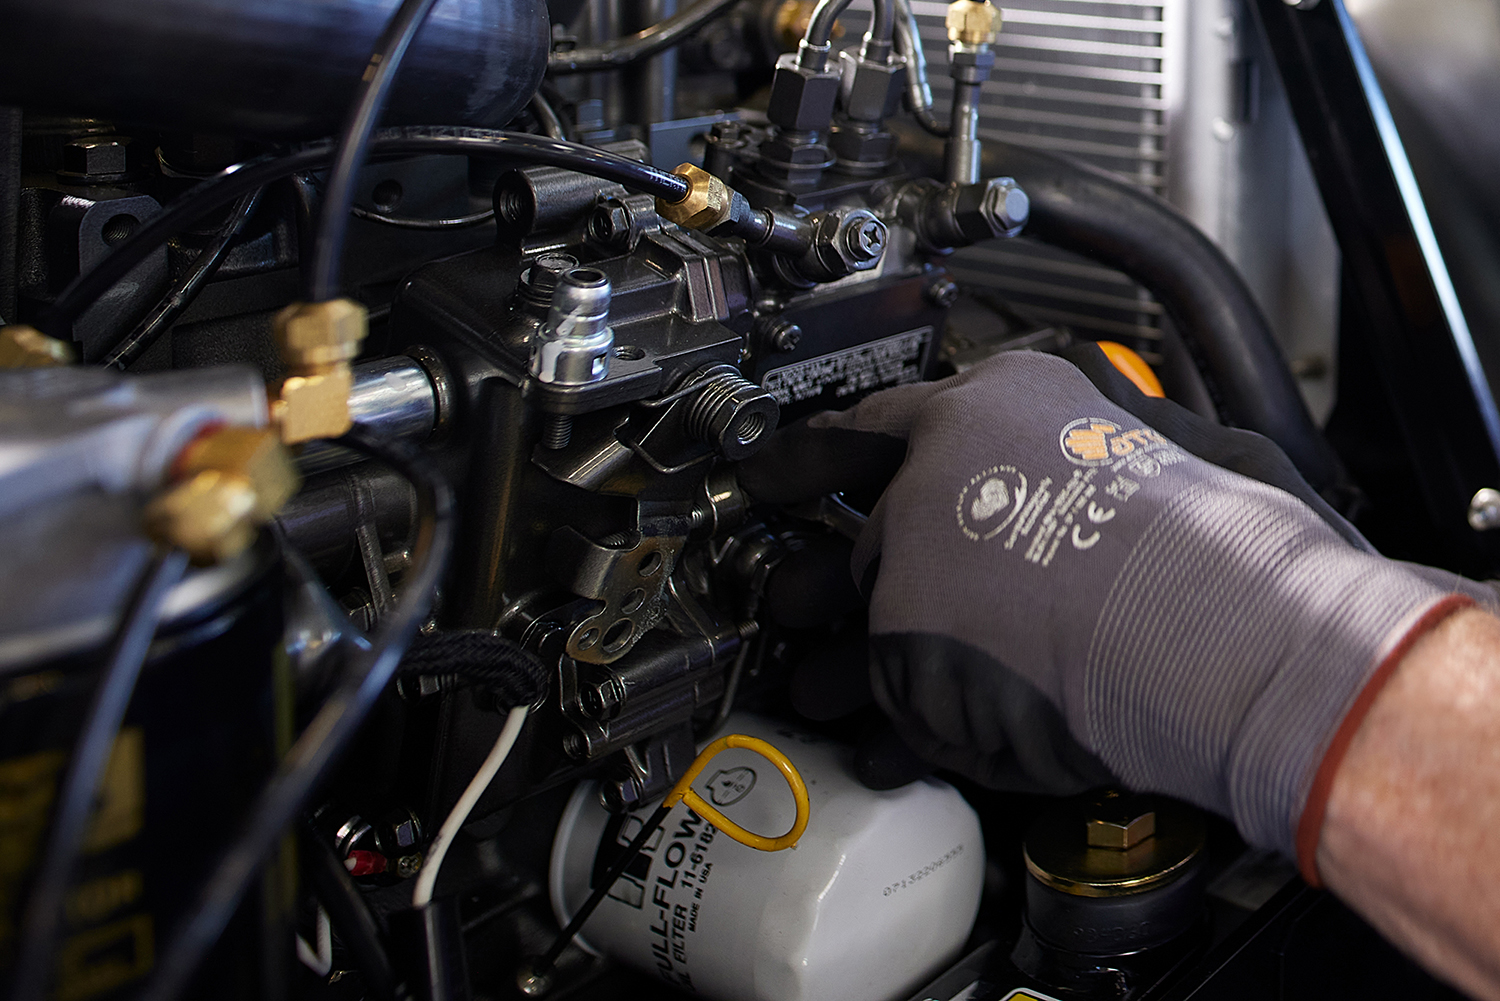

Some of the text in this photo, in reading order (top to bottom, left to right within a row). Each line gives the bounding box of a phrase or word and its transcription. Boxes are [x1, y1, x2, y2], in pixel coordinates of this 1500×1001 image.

[671, 903, 688, 965] FILTER
[681, 823, 718, 889] 11-6182
[687, 862, 714, 933] MADE IN USA
